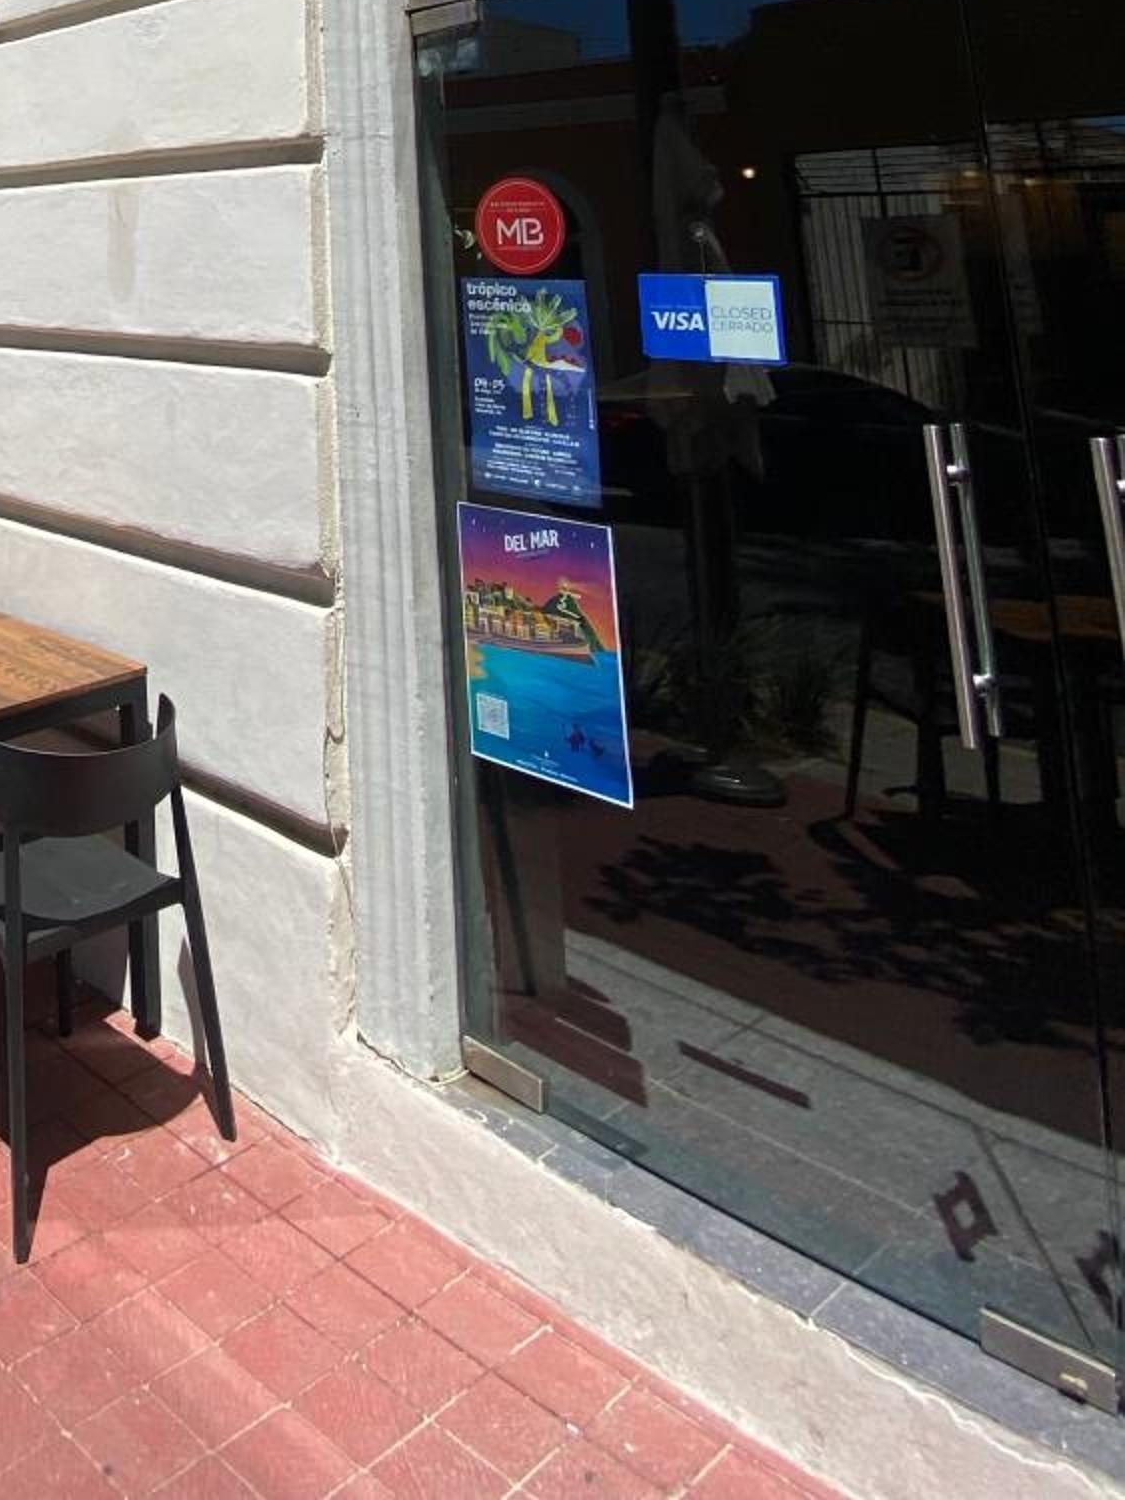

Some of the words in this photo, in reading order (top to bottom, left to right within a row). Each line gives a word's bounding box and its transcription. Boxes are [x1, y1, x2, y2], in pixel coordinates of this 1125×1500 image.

[651, 311, 706, 331] VISA
[711, 306, 773, 320] CLOSED
[504, 533, 527, 552] DEL
[530, 529, 560, 549] MAR
